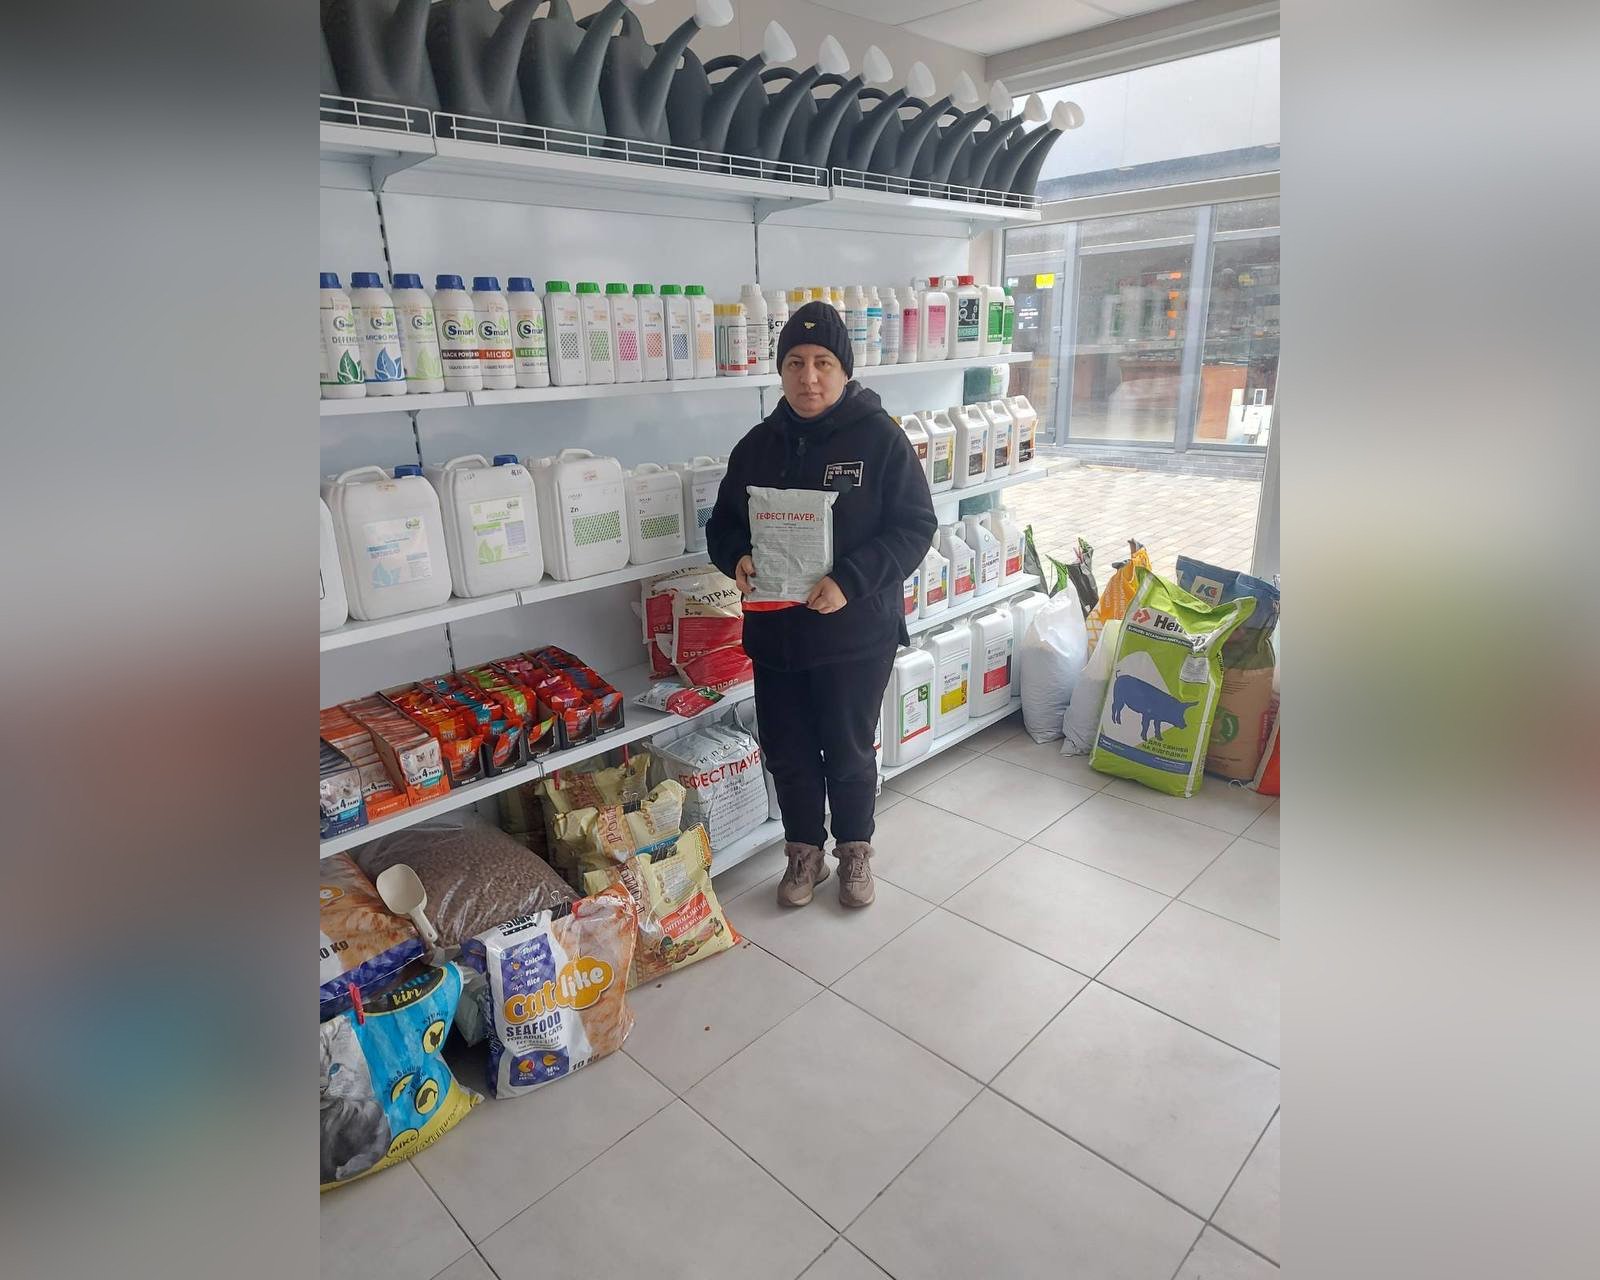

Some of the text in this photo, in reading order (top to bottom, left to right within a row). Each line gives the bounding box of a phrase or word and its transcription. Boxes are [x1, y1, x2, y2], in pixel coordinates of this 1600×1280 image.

[447, 324, 474, 336] Smart
[484, 325, 509, 336] Smart
[486, 350, 511, 359] MICRO
[756, 512, 785, 520] ГЕФЕСТ
[421, 768, 428, 778] 4
[340, 799, 347, 808] 4
[504, 967, 604, 1024] Cat like
[506, 1011, 561, 1037] SEAFOOD
[548, 1024, 563, 1037] CATS
[572, 1060, 585, 1071] 10
